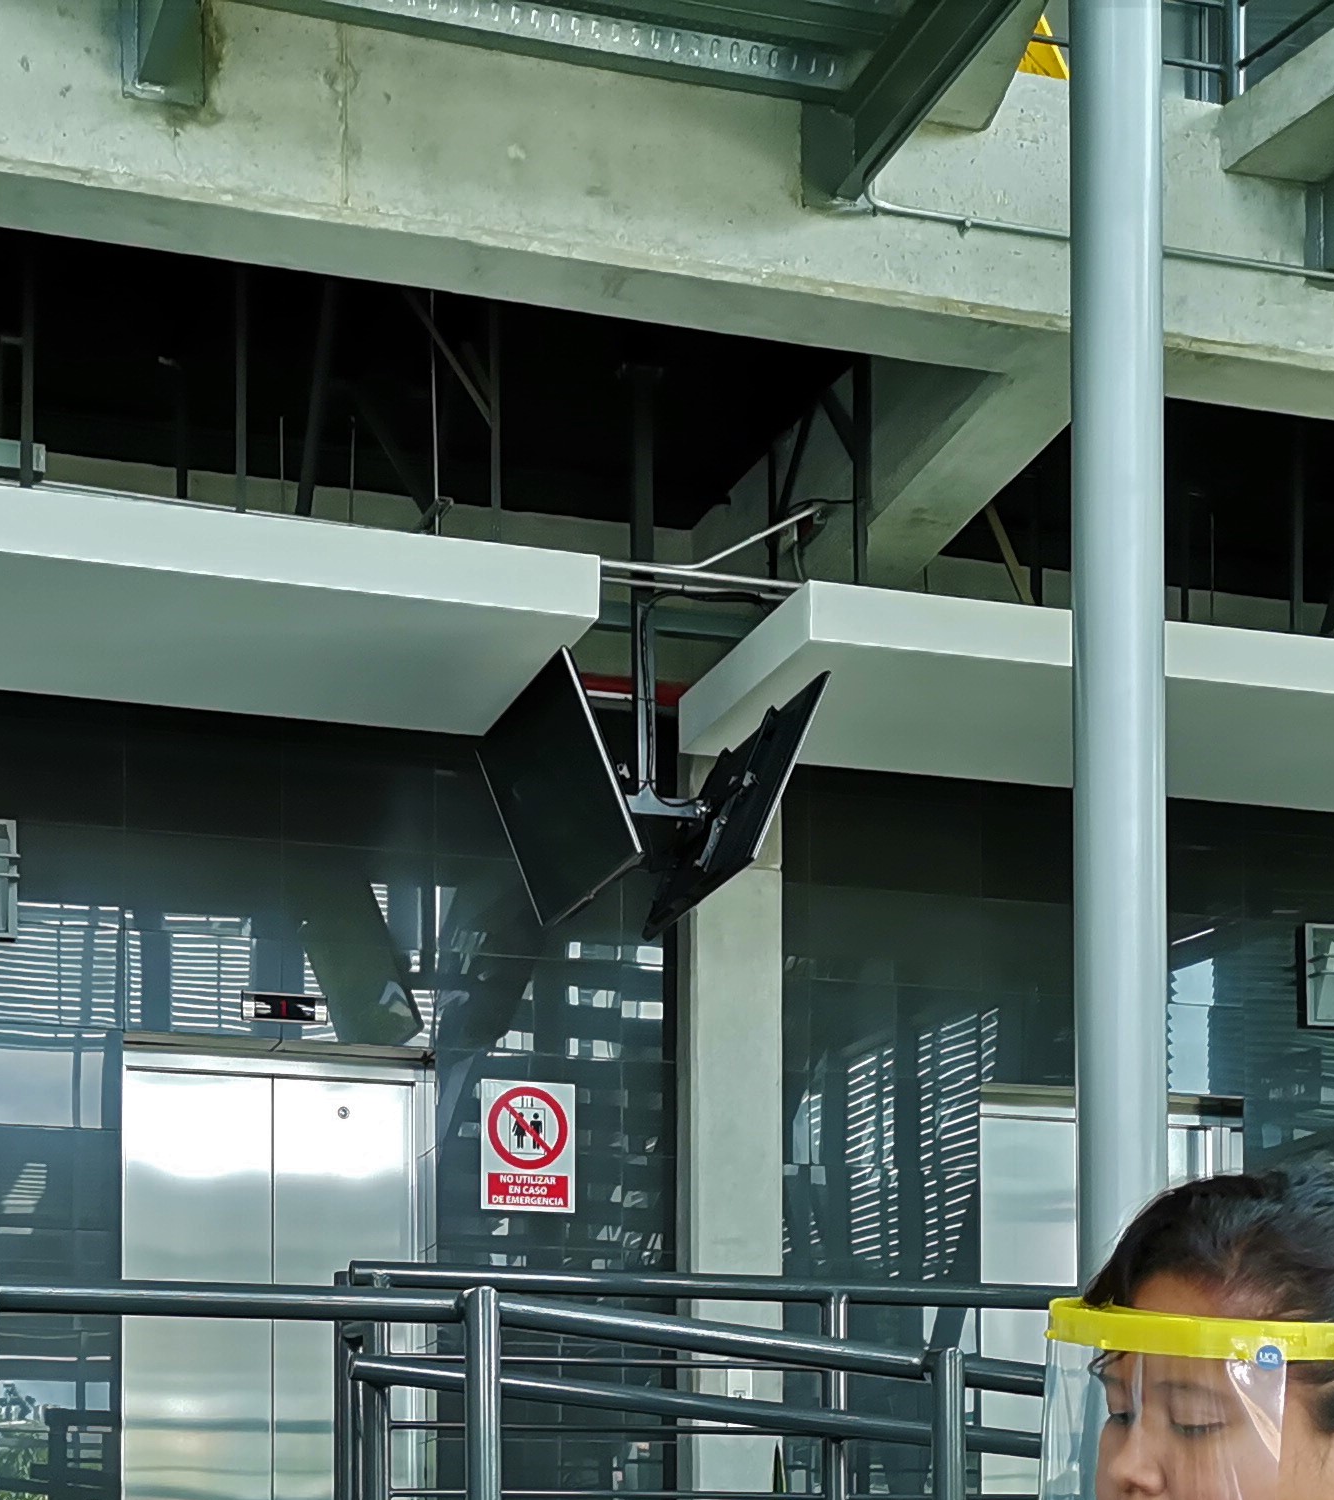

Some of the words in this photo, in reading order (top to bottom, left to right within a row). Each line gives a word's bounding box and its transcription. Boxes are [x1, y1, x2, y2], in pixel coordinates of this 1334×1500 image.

[499, 1174, 513, 1184] NO
[515, 1175, 556, 1185] UTILIZAR
[508, 1185, 520, 1194] EN
[522, 1186, 548, 1195] CASO
[491, 1195, 504, 1204] DE
[505, 1196, 564, 1206] EMERGENCIA
[1260, 1351, 1278, 1363] UCR
